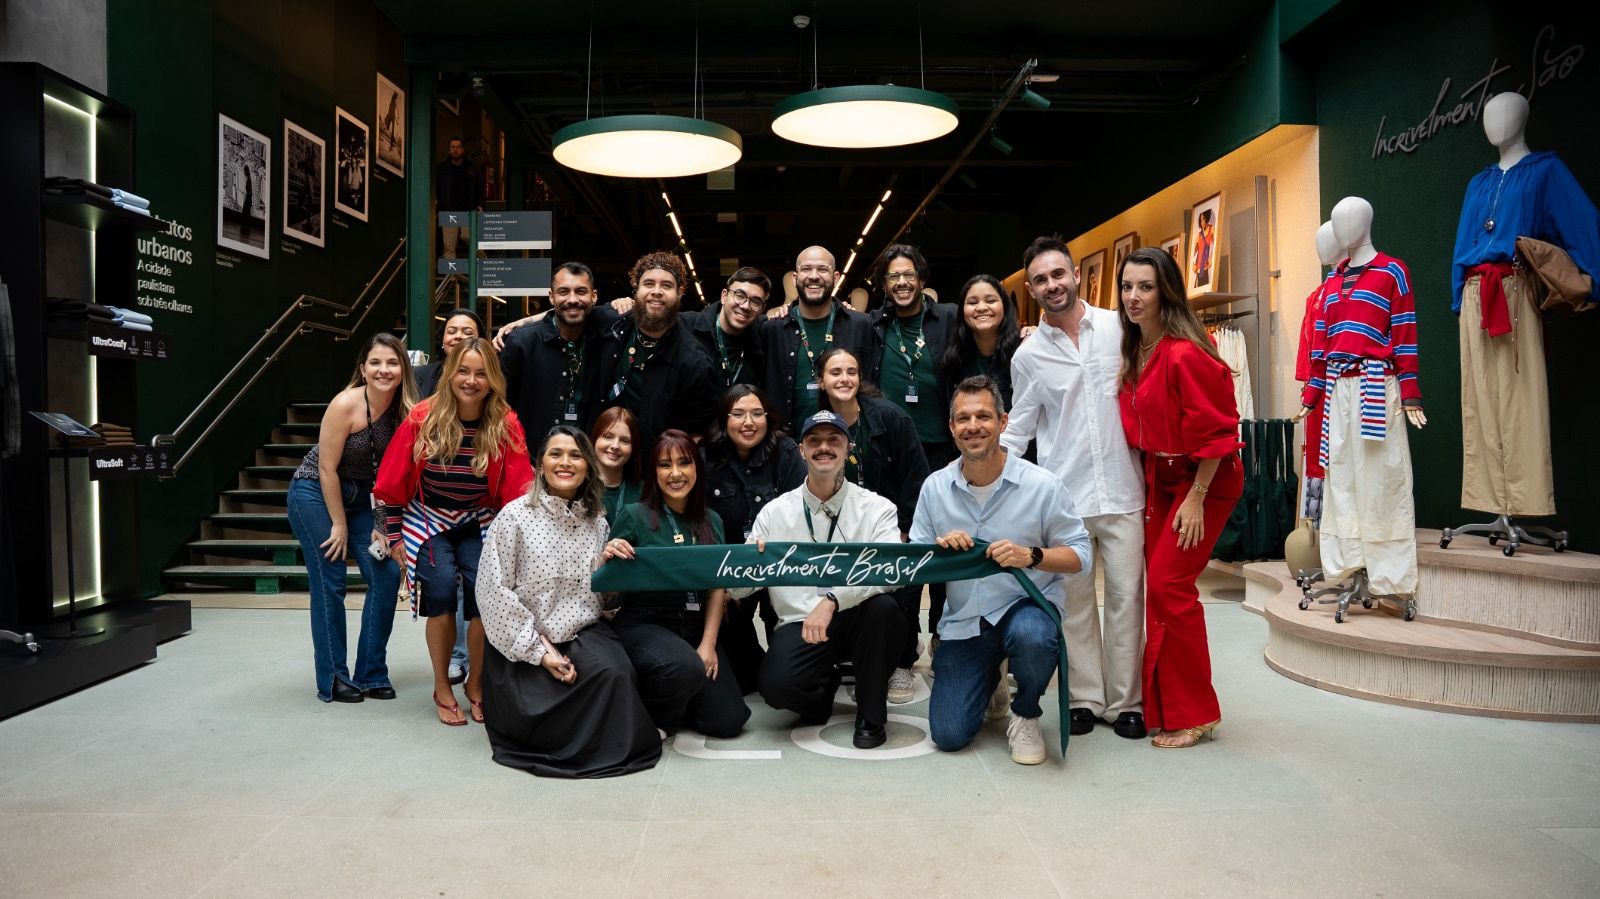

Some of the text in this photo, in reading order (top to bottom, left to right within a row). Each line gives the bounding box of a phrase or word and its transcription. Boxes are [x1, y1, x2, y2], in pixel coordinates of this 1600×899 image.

[1517, 24, 1585, 103] São
[137, 237, 193, 265] urbanos
[137, 259, 172, 277] A cidade
[137, 279, 175, 294] paulistana
[137, 295, 193, 314] sob três olhares
[92, 336, 127, 351] UltraComfy
[96, 457, 124, 469] UltraSoft
[846, 546, 934, 586] Brasil
